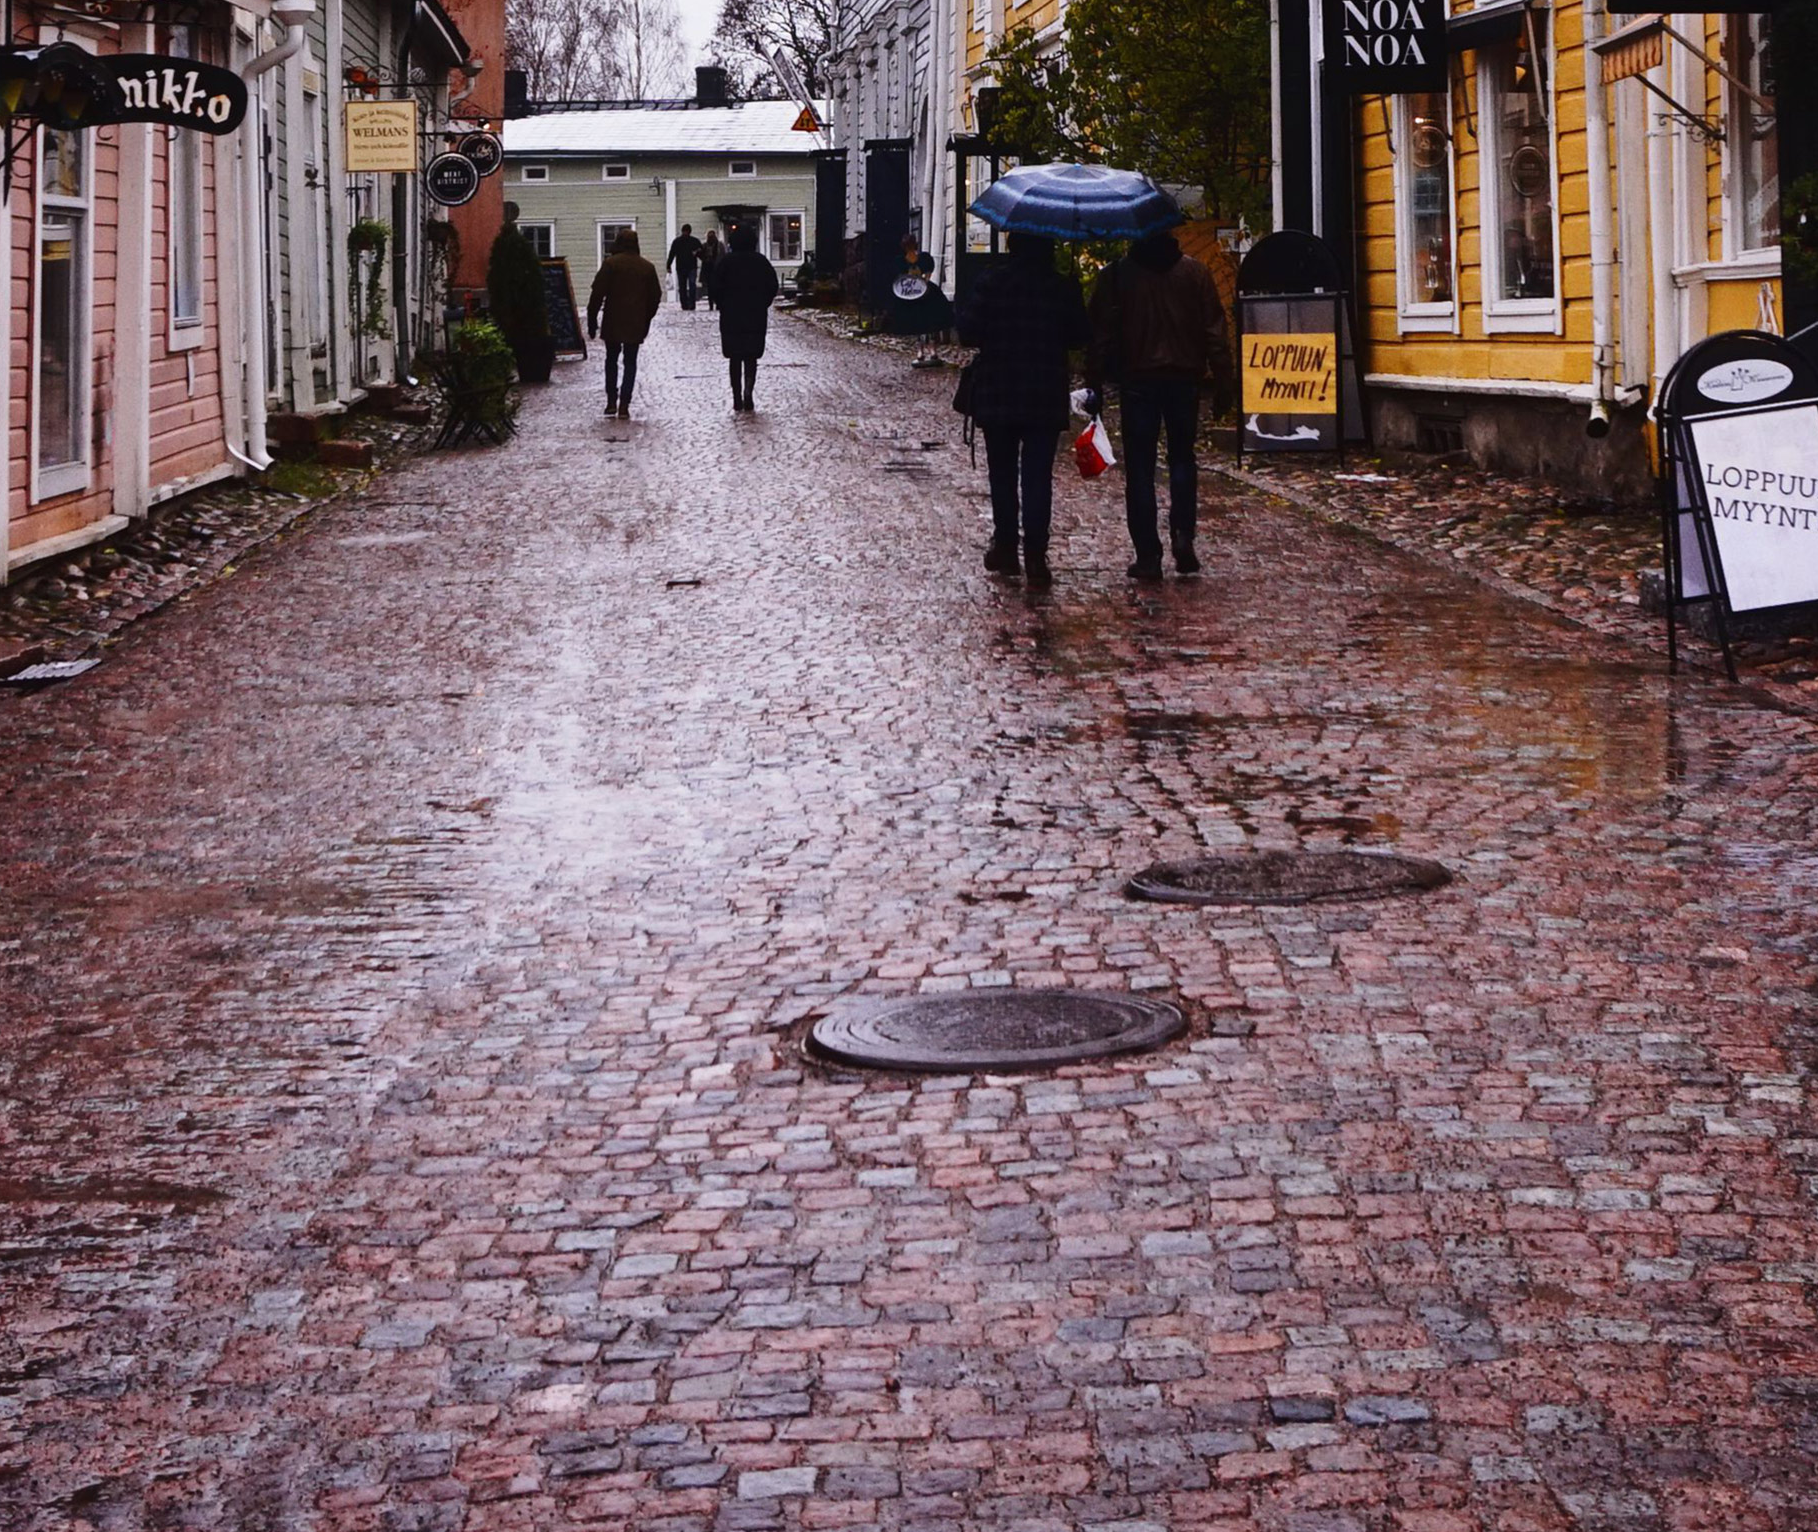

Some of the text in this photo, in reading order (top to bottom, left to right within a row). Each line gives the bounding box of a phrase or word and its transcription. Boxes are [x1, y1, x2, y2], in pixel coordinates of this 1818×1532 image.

[1343, 33, 1427, 66] NOA
[353, 127, 409, 138] WELMANS
[1249, 342, 1328, 372] LOPPUUN
